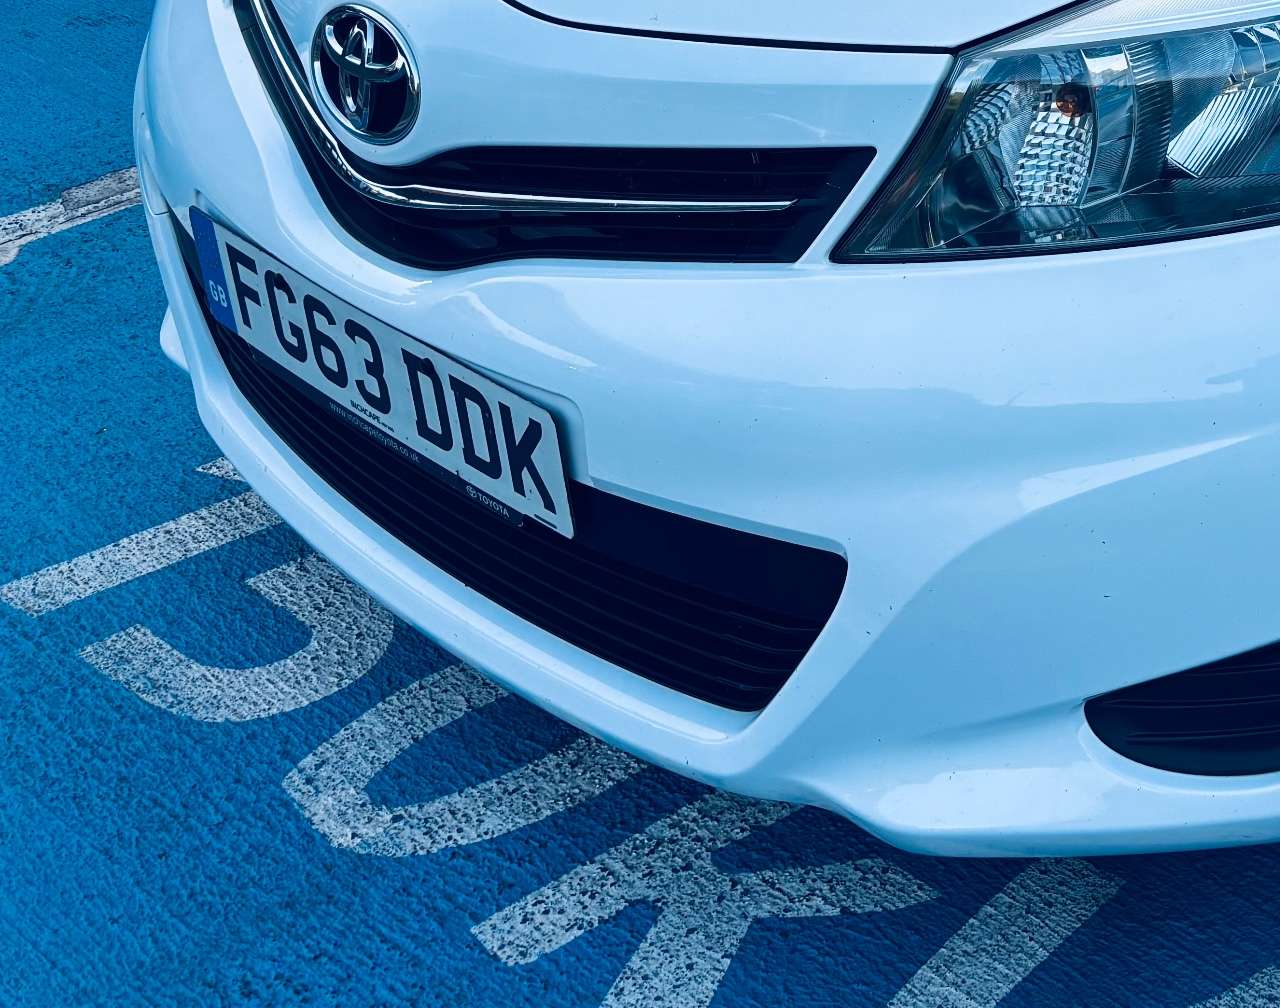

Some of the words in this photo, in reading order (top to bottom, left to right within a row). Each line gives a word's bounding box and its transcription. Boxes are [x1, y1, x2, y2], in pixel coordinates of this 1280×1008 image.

[208, 279, 228, 308] GB
[224, 242, 391, 414] FG63
[401, 348, 556, 515] DDK
[477, 494, 511, 519] TOYOTA
